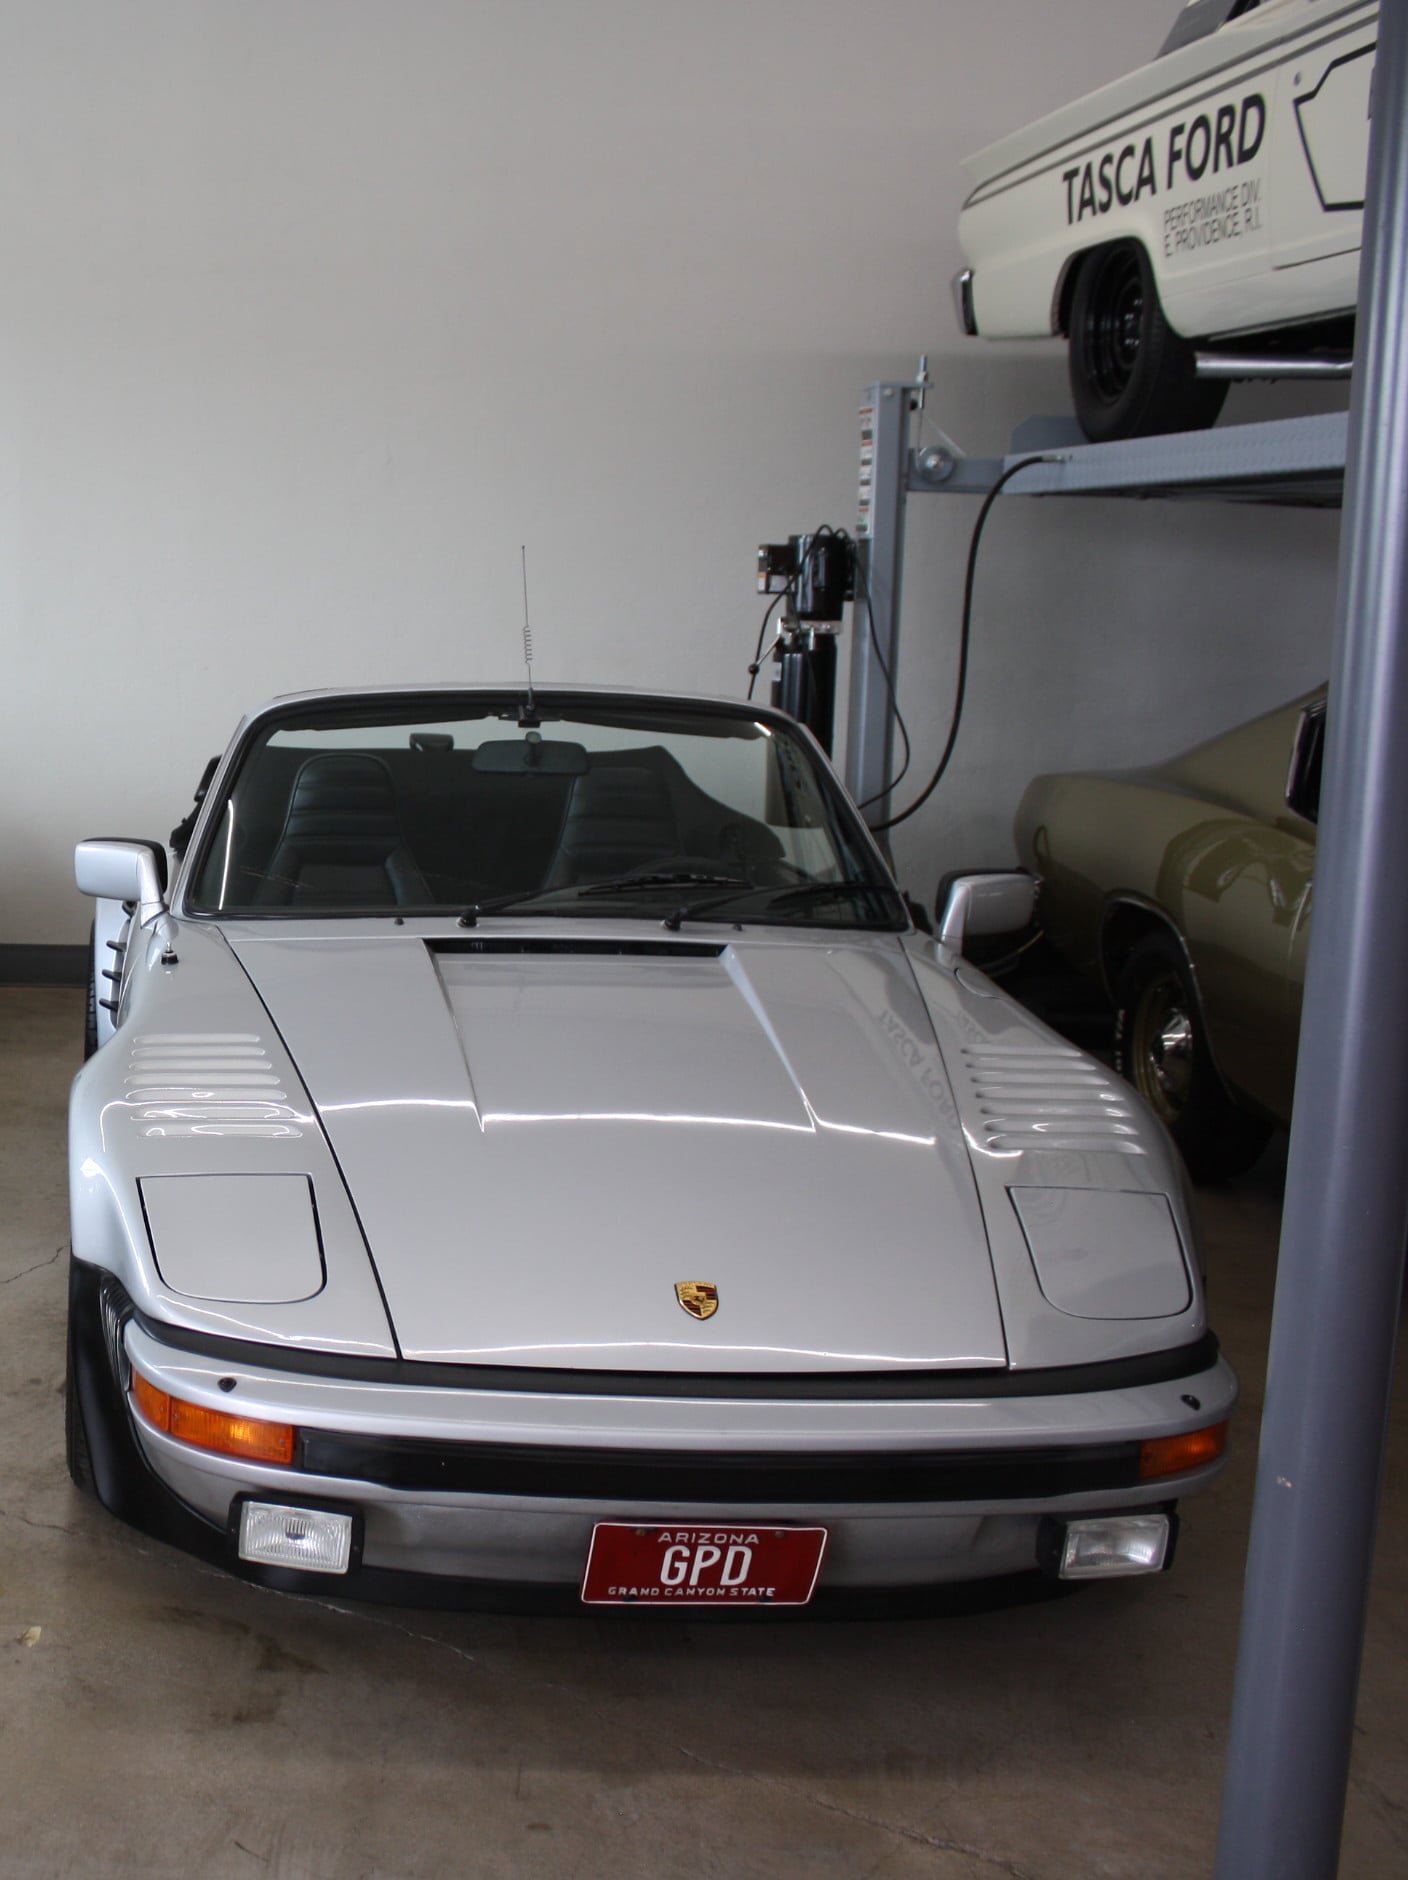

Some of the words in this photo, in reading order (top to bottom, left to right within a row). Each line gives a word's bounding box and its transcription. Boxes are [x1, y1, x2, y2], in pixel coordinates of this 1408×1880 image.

[1062, 136, 1157, 225] TASCA
[1166, 93, 1267, 190] FORD
[1164, 184, 1239, 231] PERFORMANCE
[1241, 178, 1262, 207] DIV.
[658, 1532, 760, 1545] ARIZONA
[660, 1545, 753, 1586] GPD
[607, 1586, 660, 1596] GRAND
[663, 1587, 726, 1597] CANYON
[729, 1587, 776, 1597] STATE
